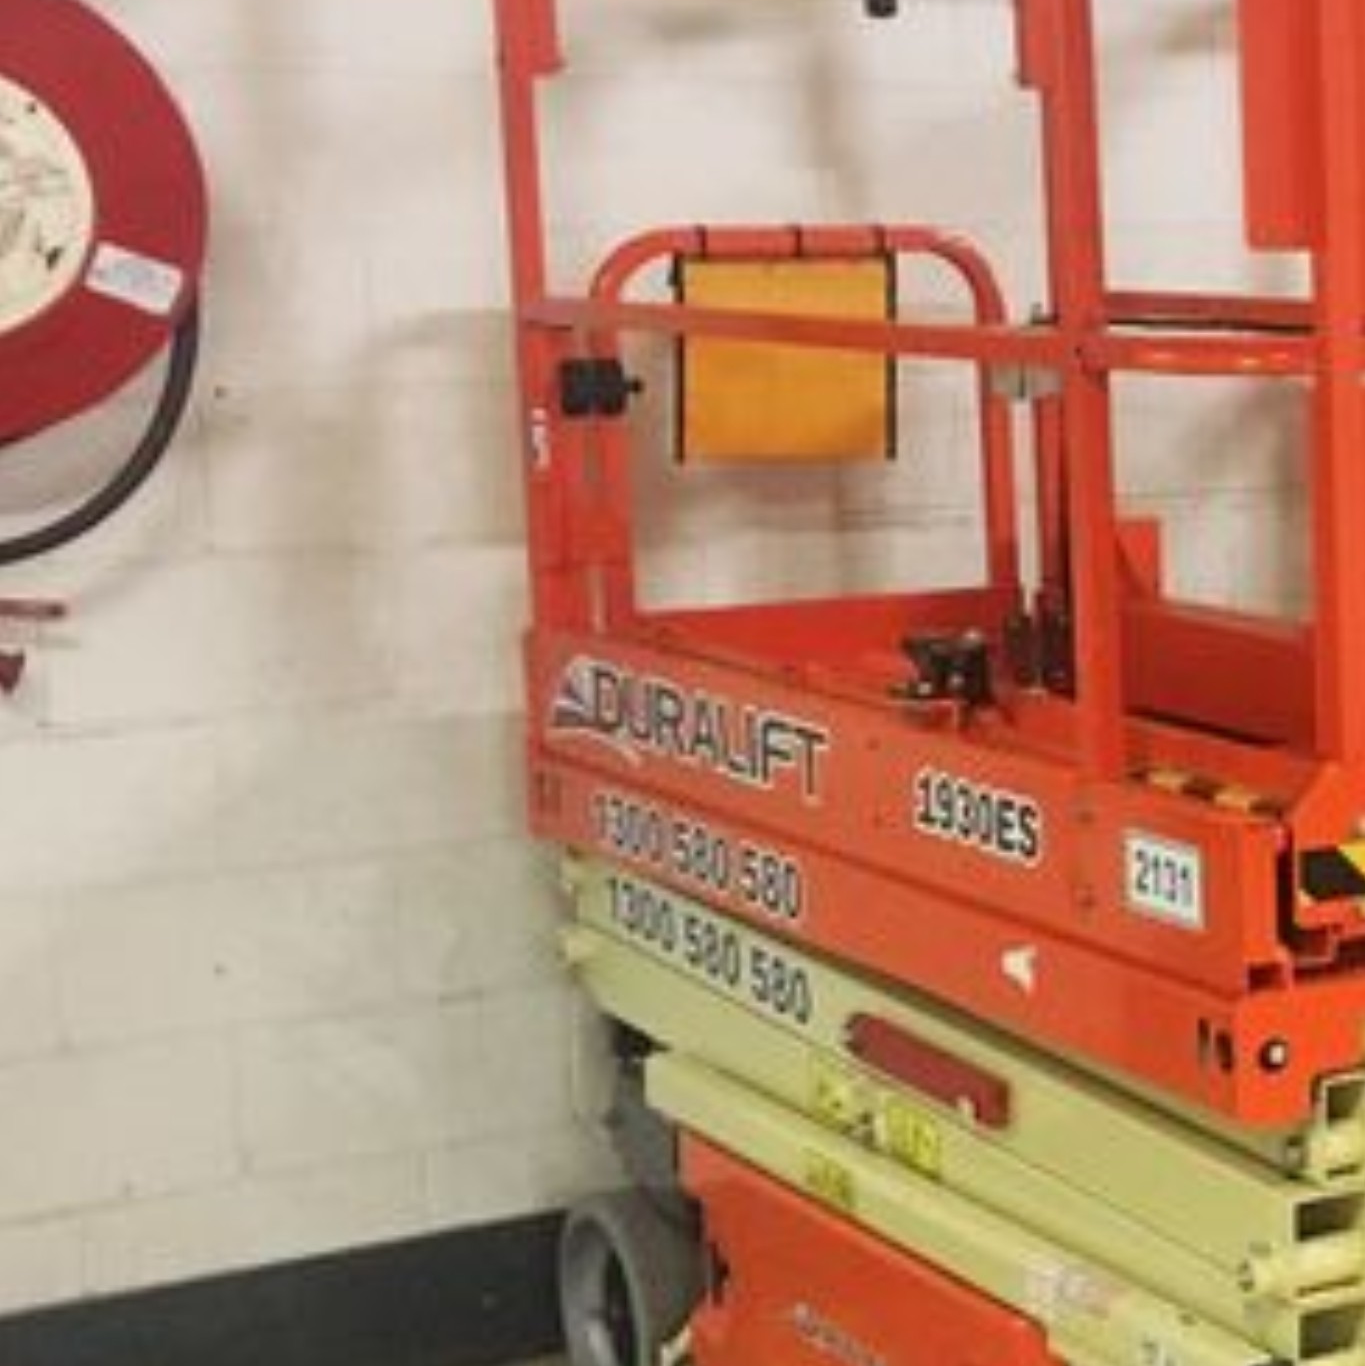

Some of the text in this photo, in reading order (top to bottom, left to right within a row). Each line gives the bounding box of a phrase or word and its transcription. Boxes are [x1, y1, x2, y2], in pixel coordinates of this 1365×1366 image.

[590, 663, 828, 798] DURALIFT
[916, 773, 1039, 860] 1930ES
[741, 847, 801, 917] 580
[751, 949, 813, 1025] 580
